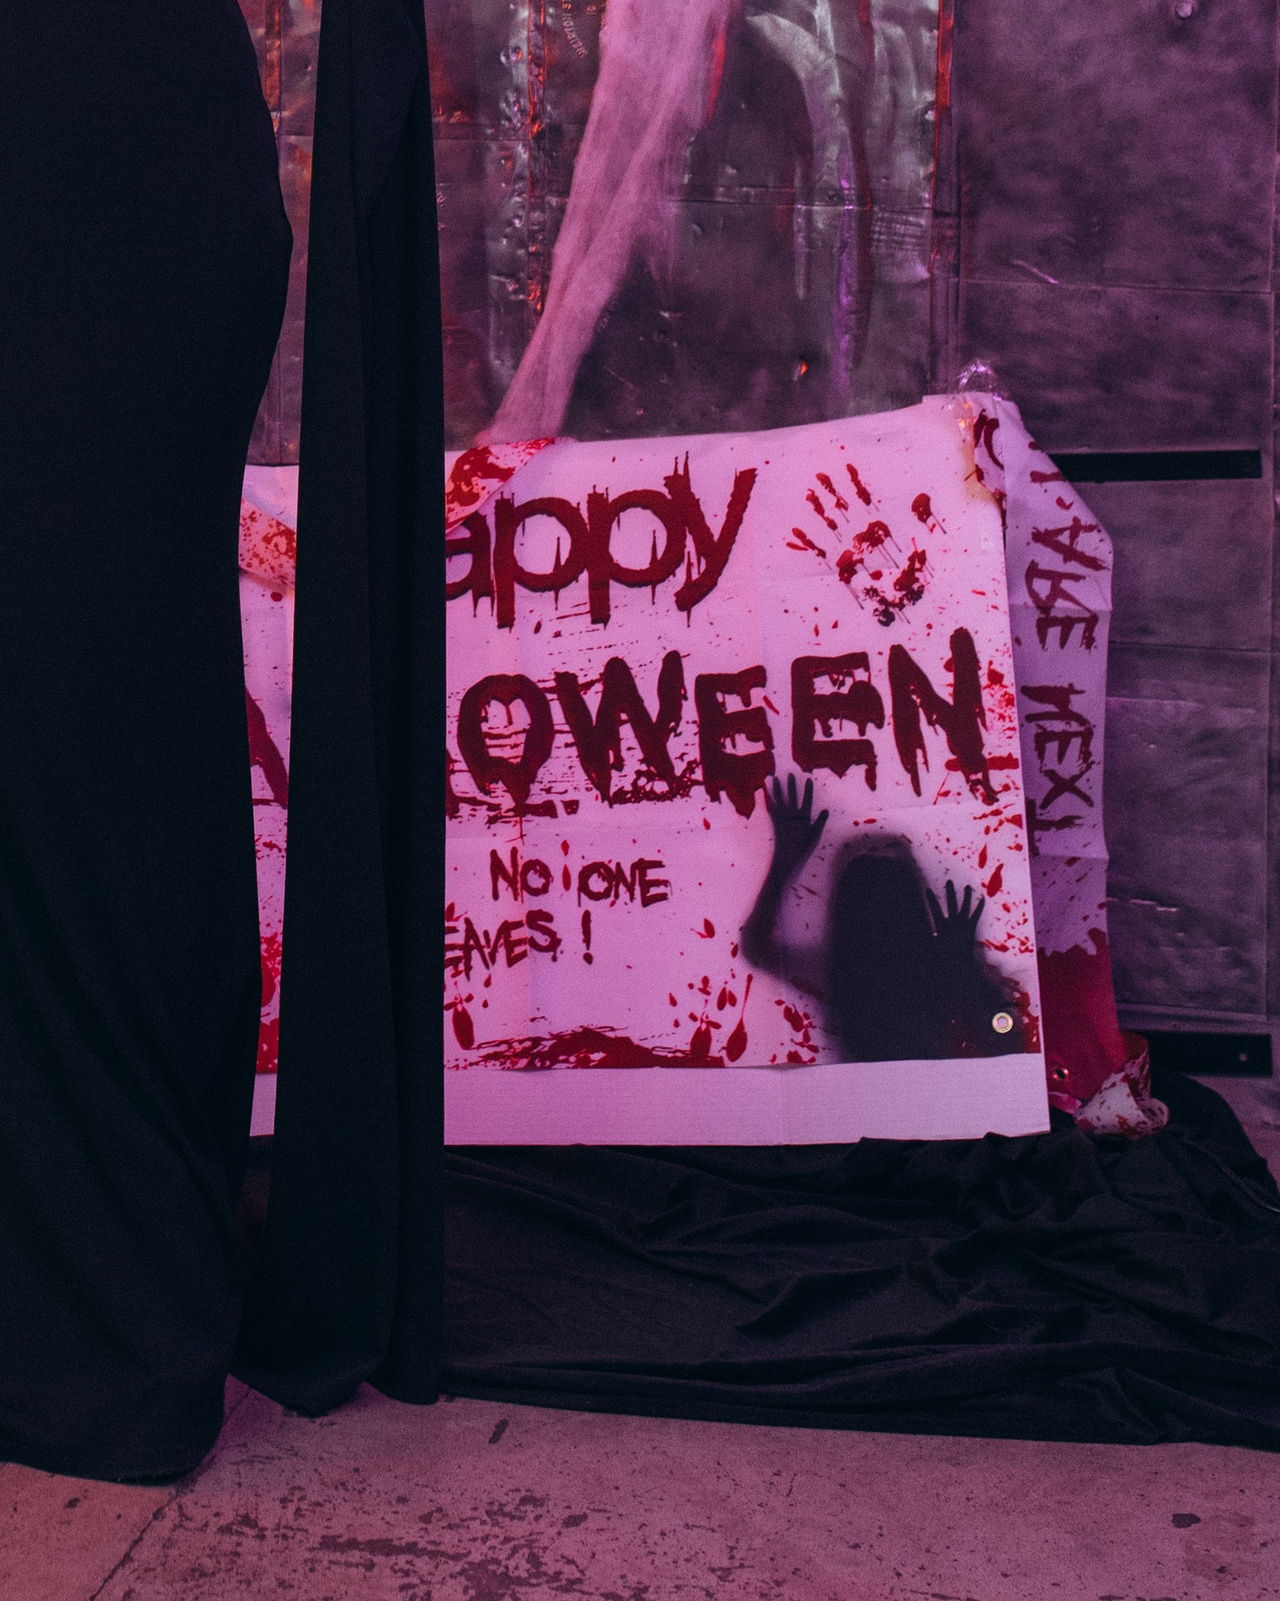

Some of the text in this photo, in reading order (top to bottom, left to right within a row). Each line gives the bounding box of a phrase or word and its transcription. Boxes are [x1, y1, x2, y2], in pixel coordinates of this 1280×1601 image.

[445, 456, 757, 630] appy
[457, 626, 999, 818] OWEEN
[489, 846, 672, 907] NO ONE
